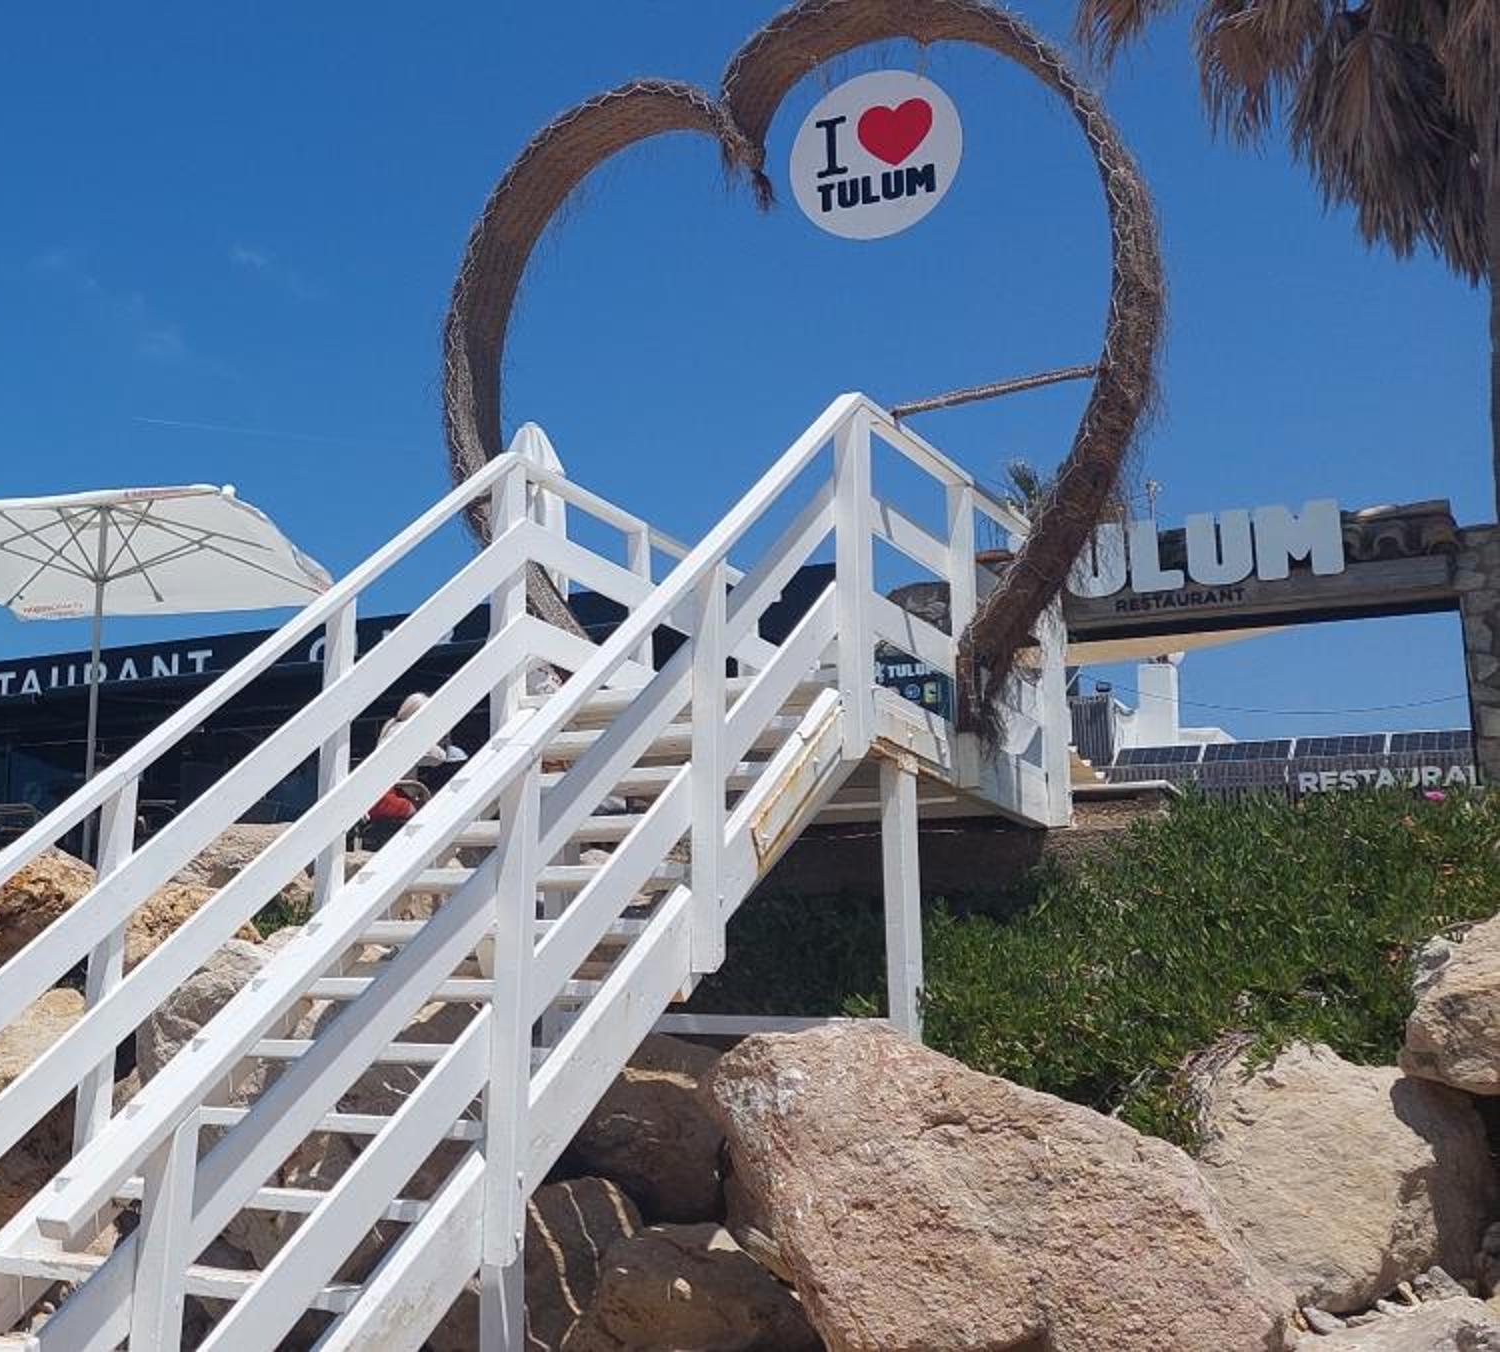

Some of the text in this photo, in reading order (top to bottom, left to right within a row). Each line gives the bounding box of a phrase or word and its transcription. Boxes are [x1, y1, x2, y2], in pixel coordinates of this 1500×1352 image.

[815, 115, 848, 179] I
[817, 163, 937, 213] TULUM
[1066, 499, 1346, 598] ULUM
[1114, 586, 1246, 613] RESTAURANT
[887, 662, 932, 679] TULU
[1299, 764, 1478, 794] RESTAURA
